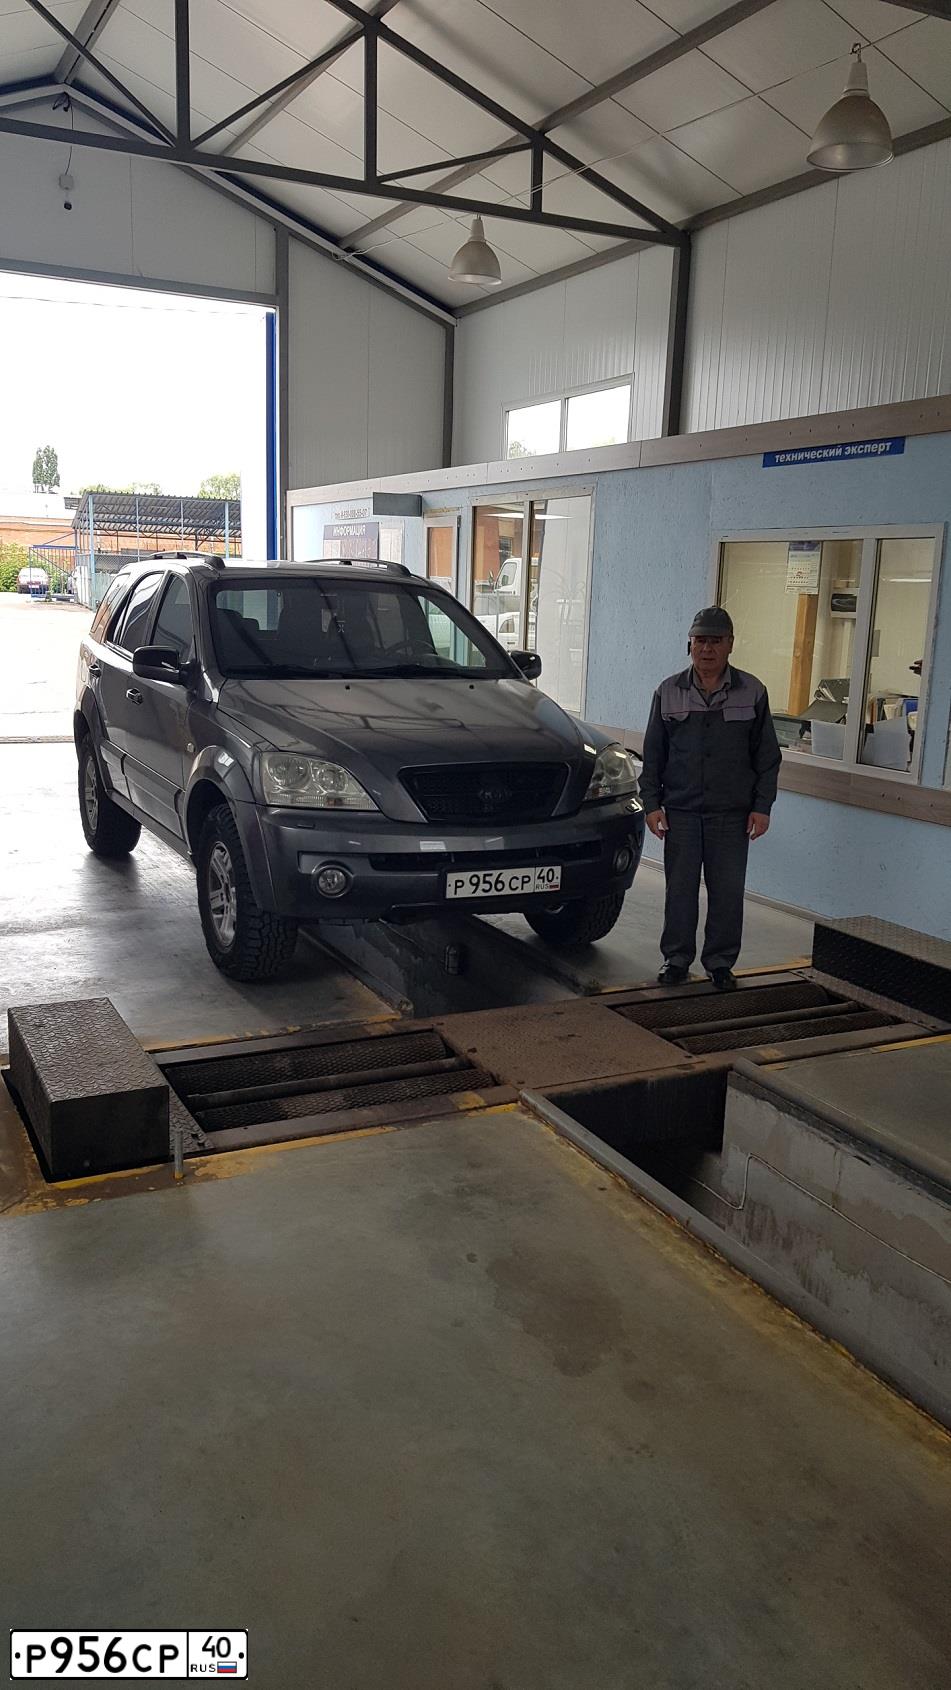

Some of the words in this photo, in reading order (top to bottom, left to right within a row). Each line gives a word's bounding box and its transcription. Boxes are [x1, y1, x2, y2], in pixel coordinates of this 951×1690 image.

[774, 445, 842, 463] технический
[844, 440, 892, 455] эксперт
[537, 868, 555, 883] 40
